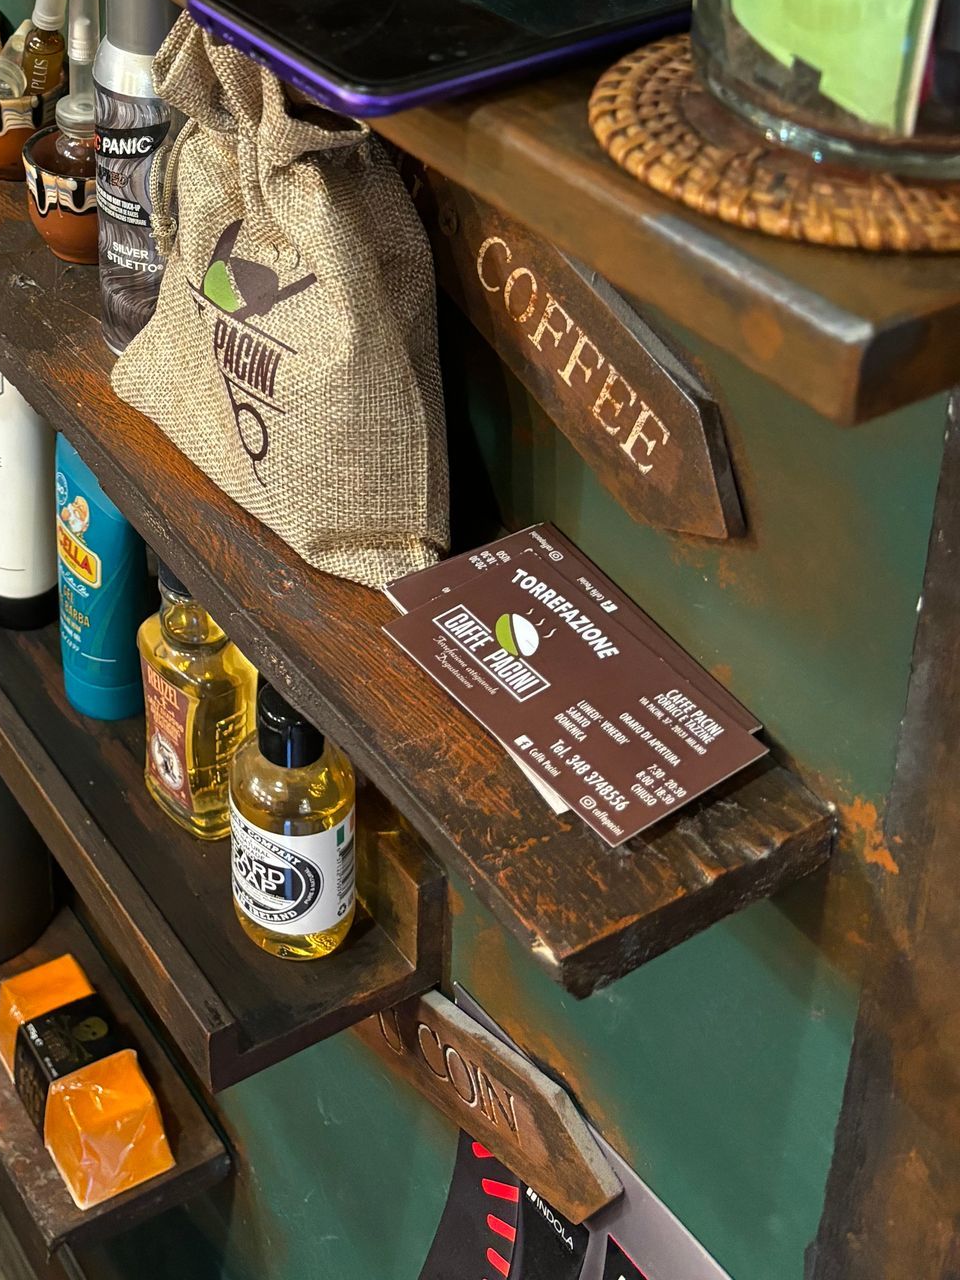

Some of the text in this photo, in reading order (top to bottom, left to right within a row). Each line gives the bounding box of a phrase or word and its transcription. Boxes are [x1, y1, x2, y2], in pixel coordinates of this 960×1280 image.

[30, 58, 49, 91] PLUS
[102, 135, 154, 155] PANIC
[112, 240, 149, 260] SILVER
[213, 317, 281, 398] PACINI
[475, 235, 672, 477] COFFEE
[511, 568, 620, 660] TORREFAZIONE
[443, 612, 540, 695] CAFFE PACINI
[147, 665, 180, 711] REUZEL
[554, 713, 587, 743] DOMENICA
[565, 706, 591, 728] SABATO
[639, 696, 649, 708] VIA
[684, 735, 707, 756] MILANO
[653, 693, 682, 719] FORBICI
[685, 718, 715, 745] TAZZINE
[665, 689, 724, 738] CAFFE PACINI
[619, 712, 682, 768] ORARIO DI APERTURA
[541, 760, 562, 778] Pacini
[550, 738, 630, 812] Tel. 348 3748556
[635, 770, 676, 805] 8:00 18:30
[647, 763, 688, 798] 7:30 20:30
[630, 783, 658, 807] CHIUSO
[592, 807, 625, 837] caffepacini
[246, 827, 302, 865] COMPANY
[535, 1196, 575, 1251] INDOLA
